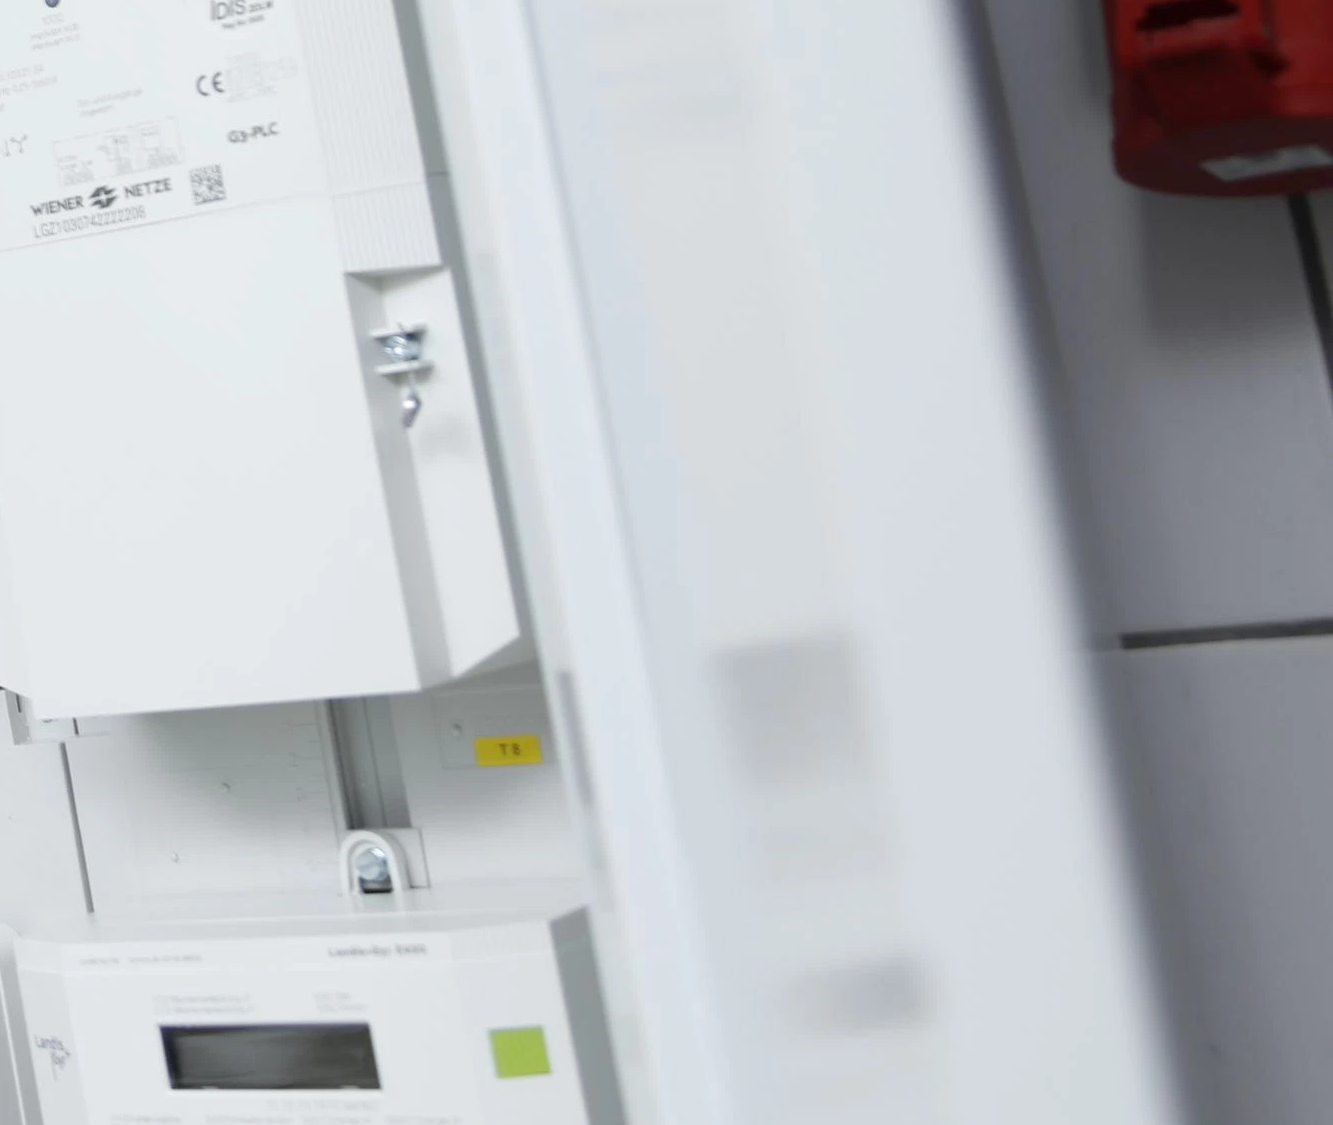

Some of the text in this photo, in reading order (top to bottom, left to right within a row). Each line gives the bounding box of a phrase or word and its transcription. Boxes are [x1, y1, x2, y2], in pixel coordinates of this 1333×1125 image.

[228, 121, 278, 143] G3-PLC
[30, 178, 171, 215] WIENER NETZE
